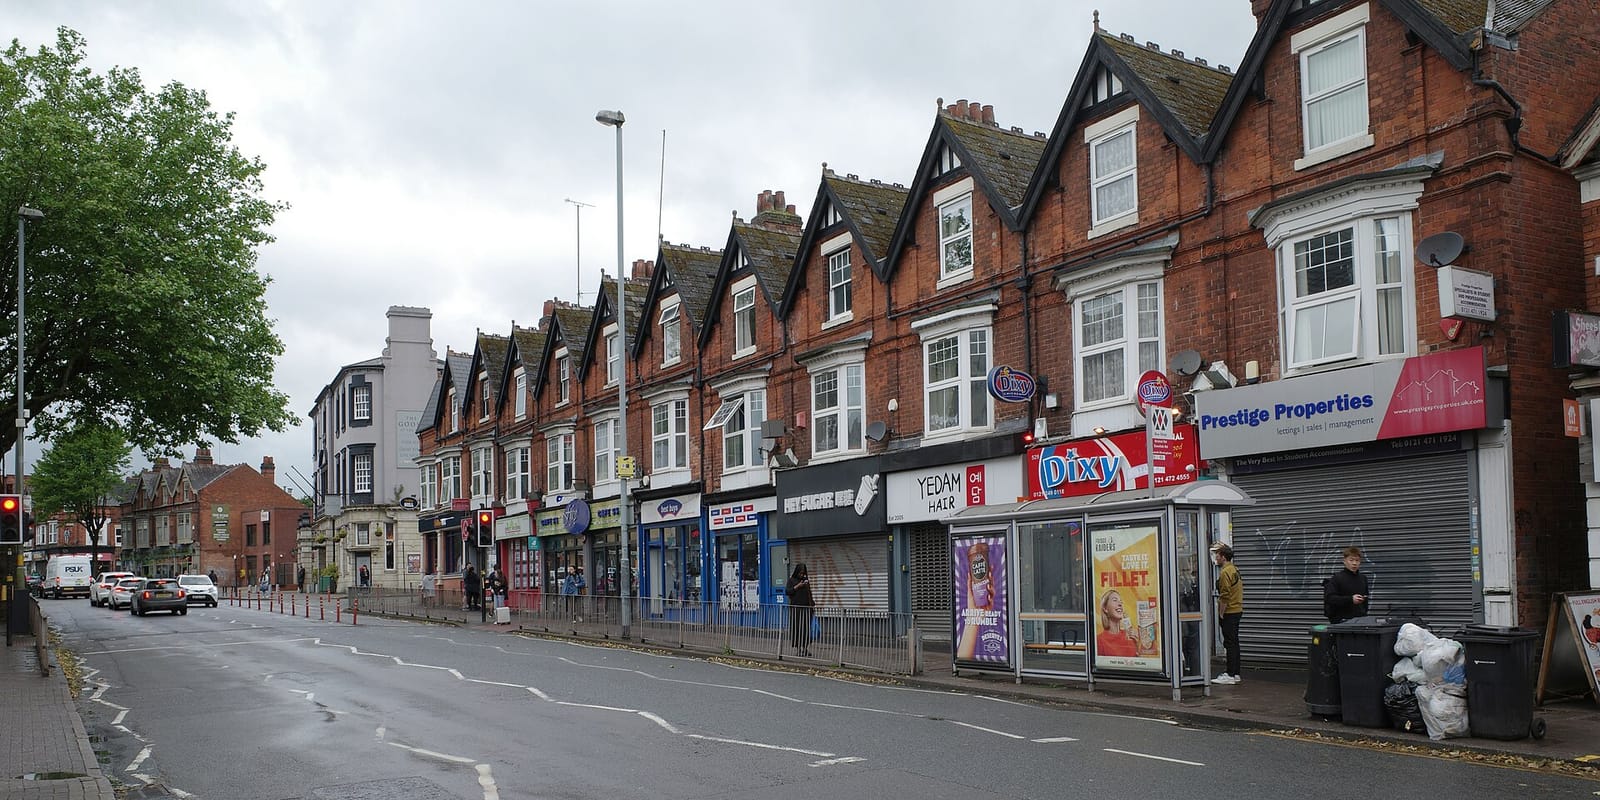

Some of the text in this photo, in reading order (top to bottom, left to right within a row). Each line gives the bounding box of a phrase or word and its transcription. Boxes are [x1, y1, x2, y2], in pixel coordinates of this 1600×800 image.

[1001, 376, 1030, 394] Dixy
[1143, 384, 1168, 396] Dixy
[1201, 393, 1374, 431] Prestige Properties
[1276, 416, 1375, 437] lettings sales management
[1423, 437, 1436, 446] 471
[1042, 448, 1120, 488] Dixy
[1236, 459, 1247, 467] The
[1247, 456, 1261, 466] Very
[1261, 455, 1276, 464] Best
[1283, 452, 1309, 461] Student
[917, 472, 962, 500] YEDAM
[783, 491, 834, 514] HEY SUGAR
[928, 496, 956, 513] HAIR
[1121, 561, 1141, 570] LOVE
[1101, 570, 1150, 588] FILLET.
[961, 608, 985, 617] ARRIVE
[970, 617, 998, 626] RUMBLE
